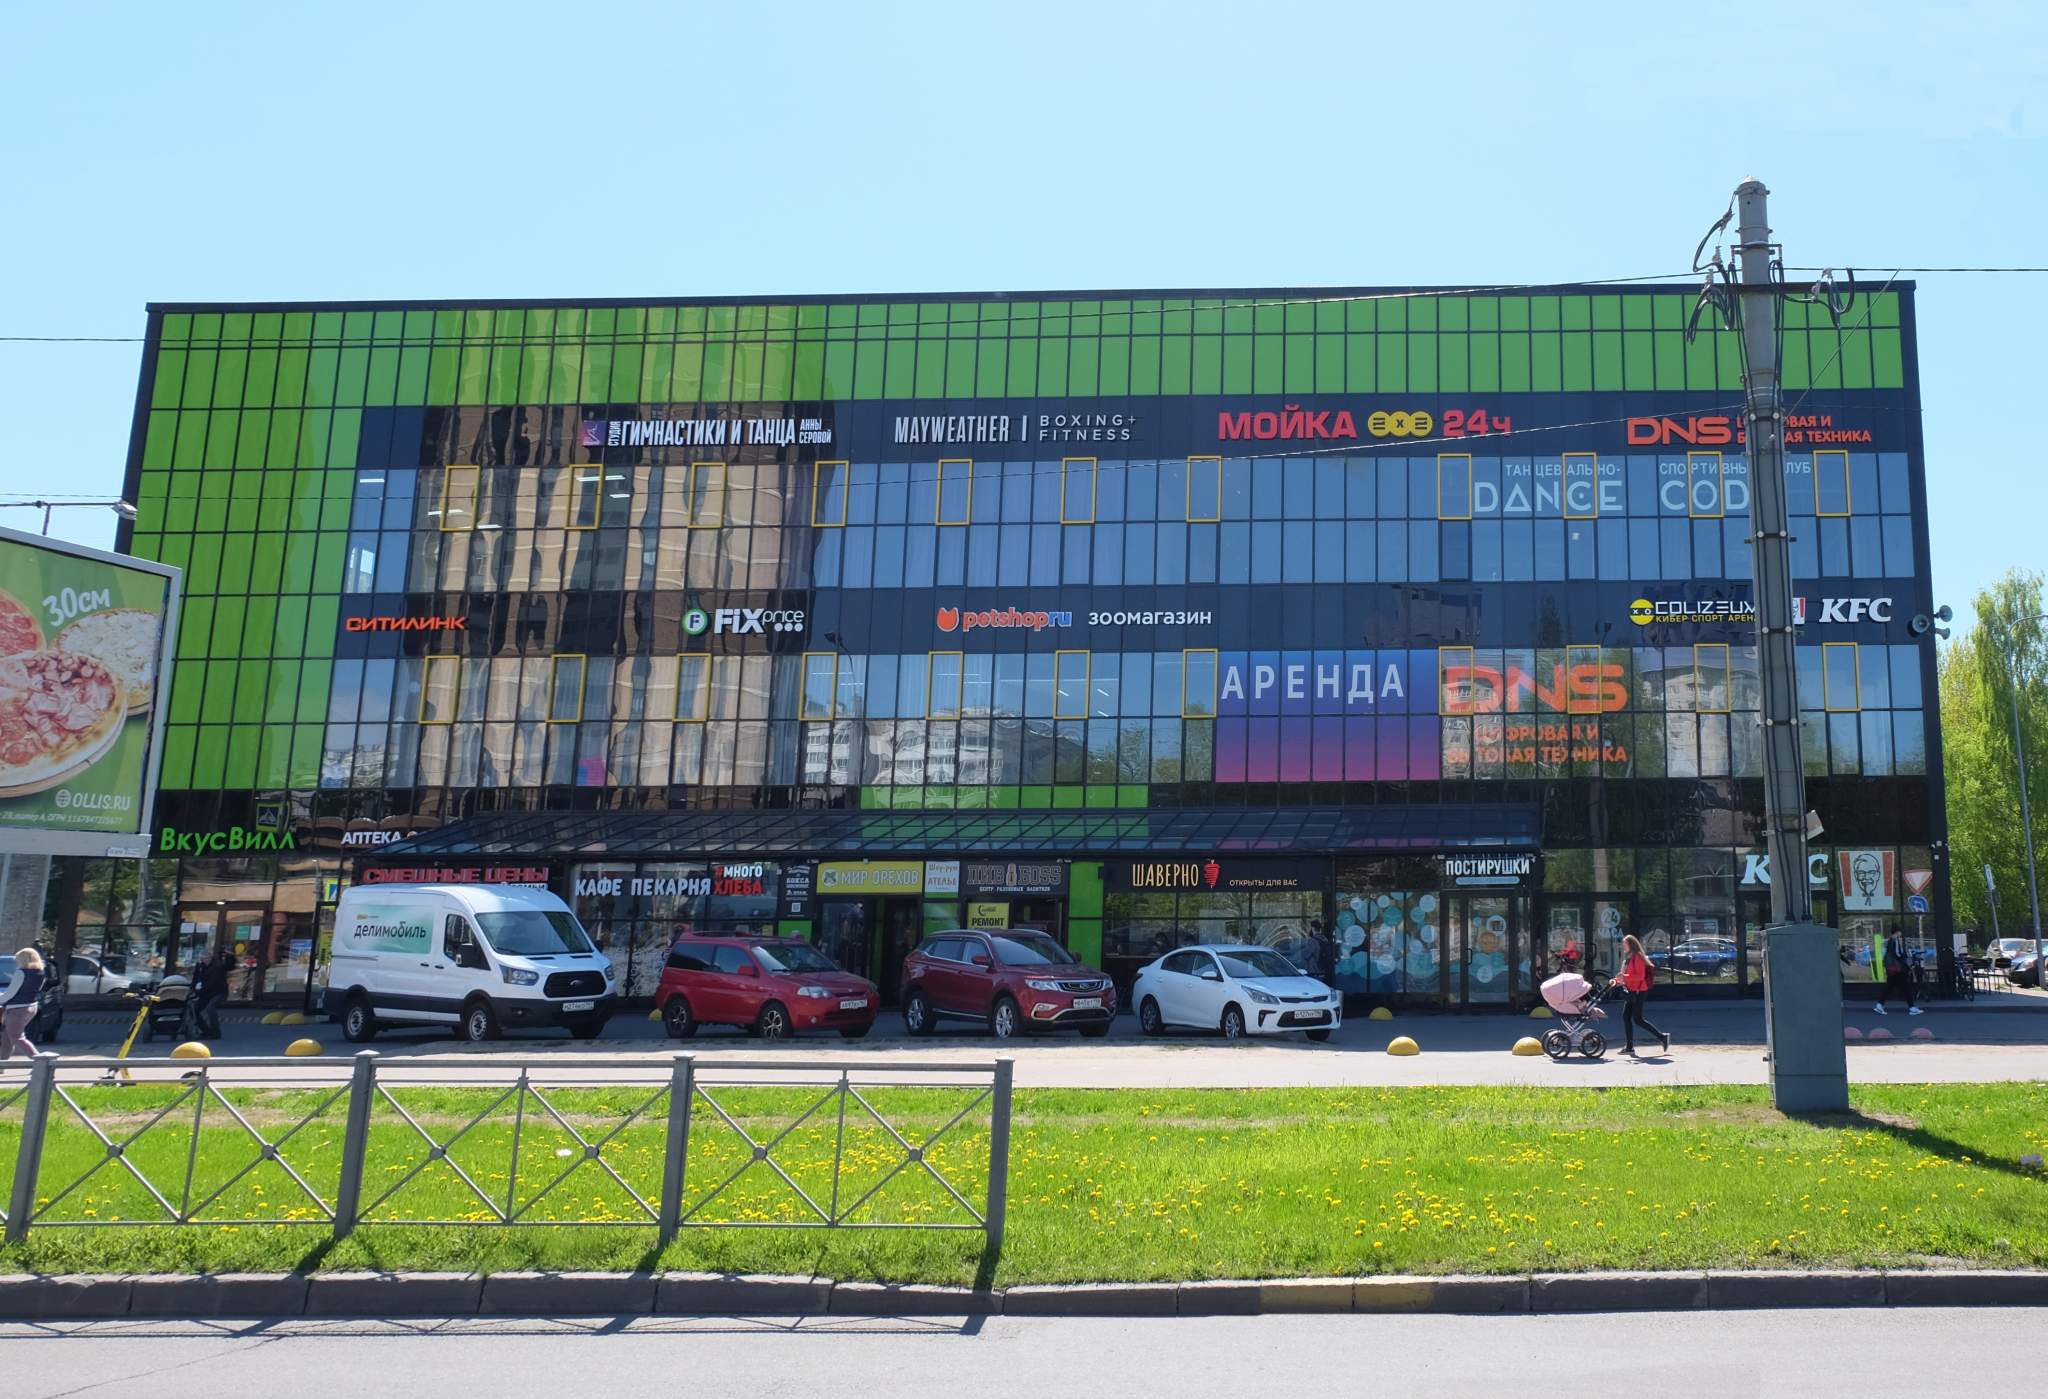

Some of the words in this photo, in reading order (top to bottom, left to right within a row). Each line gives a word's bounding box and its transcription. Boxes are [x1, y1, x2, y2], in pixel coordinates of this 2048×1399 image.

[800, 418, 822, 429] АННЫ
[895, 415, 1010, 443] MAYWEATHER
[1218, 404, 1357, 439] МОЙКА
[1443, 409, 1512, 437] 24ч
[1821, 416, 1832, 427] И
[608, 421, 621, 446] СТУДИЯ
[621, 419, 725, 446] ГИМНАСТИКИ
[730, 420, 742, 445] И
[747, 418, 796, 447] ТАНЦА
[800, 429, 832, 444] СЕРОВОЙ
[1040, 428, 1130, 441] FITNESS
[1627, 417, 1731, 445] DNS
[1807, 430, 1872, 443] ТЕХНИКА
[1660, 462, 1747, 475] СПОРТИВНЫ
[1785, 461, 1811, 474] ЛУБ
[1474, 480, 1623, 513] DANCE
[1660, 479, 1749, 511] COD
[762, 610, 804, 625] price
[1088, 610, 1212, 625] зоомагазин
[1656, 615, 1688, 623] КИБЕР
[1728, 614, 1756, 622] АРЕН
[1819, 598, 1892, 623] KFC
[345, 617, 465, 631] СИТИЛИНК
[1221, 664, 1404, 704] АРЕНДА
[1445, 664, 1628, 712] DNS
[1588, 724, 1599, 740] И
[72, 793, 131, 811] OLLIS.RU
[341, 831, 401, 845] АПТЕКА
[484, 867, 549, 883] ЦЕНЫ
[1132, 863, 1199, 887] ШАВЕРНО
[1445, 858, 1530, 876] ПОСТИРУШКИ
[1740, 854, 1828, 884] KC
[841, 871, 868, 885] МИР
[872, 870, 919, 885] ОРЕХОВ
[1266, 879, 1282, 887] ДЛЯ
[575, 877, 623, 896] КАФЕ
[631, 878, 711, 896] ПЕКАРНЯ
[714, 879, 763, 896] ХЛЕБА
[354, 921, 427, 939] делимобиль
[971, 917, 1005, 927] РЕМОНТ
